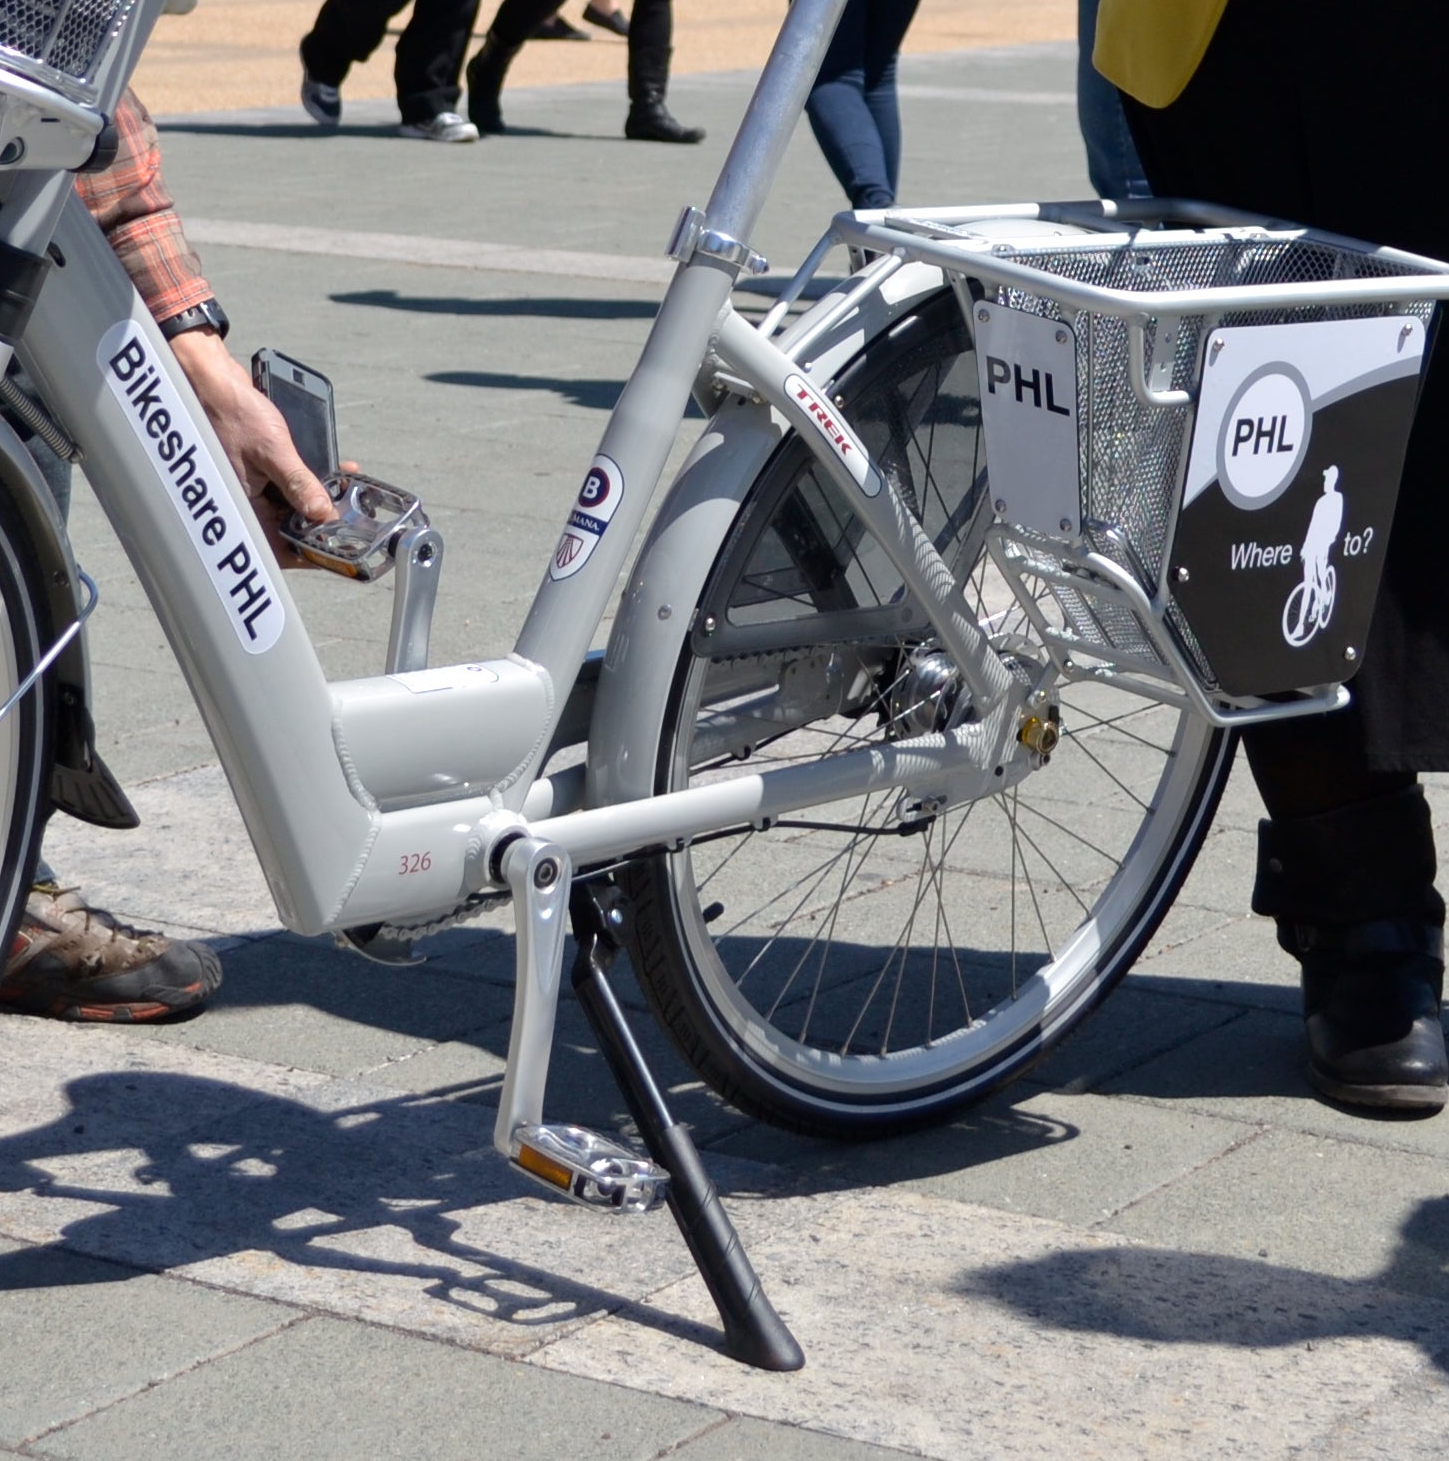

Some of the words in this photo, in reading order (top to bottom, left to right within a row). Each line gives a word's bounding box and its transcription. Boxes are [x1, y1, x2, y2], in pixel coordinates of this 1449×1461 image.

[986, 355, 1070, 417] PHL
[797, 383, 852, 455] TREK
[1232, 415, 1294, 457] PHL
[109, 336, 228, 547] Bikeshare
[216, 542, 273, 641] PHL
[582, 476, 601, 499] B
[1231, 542, 1293, 571] Where
[1343, 527, 1374, 557] to?
[398, 850, 432, 875] 326
